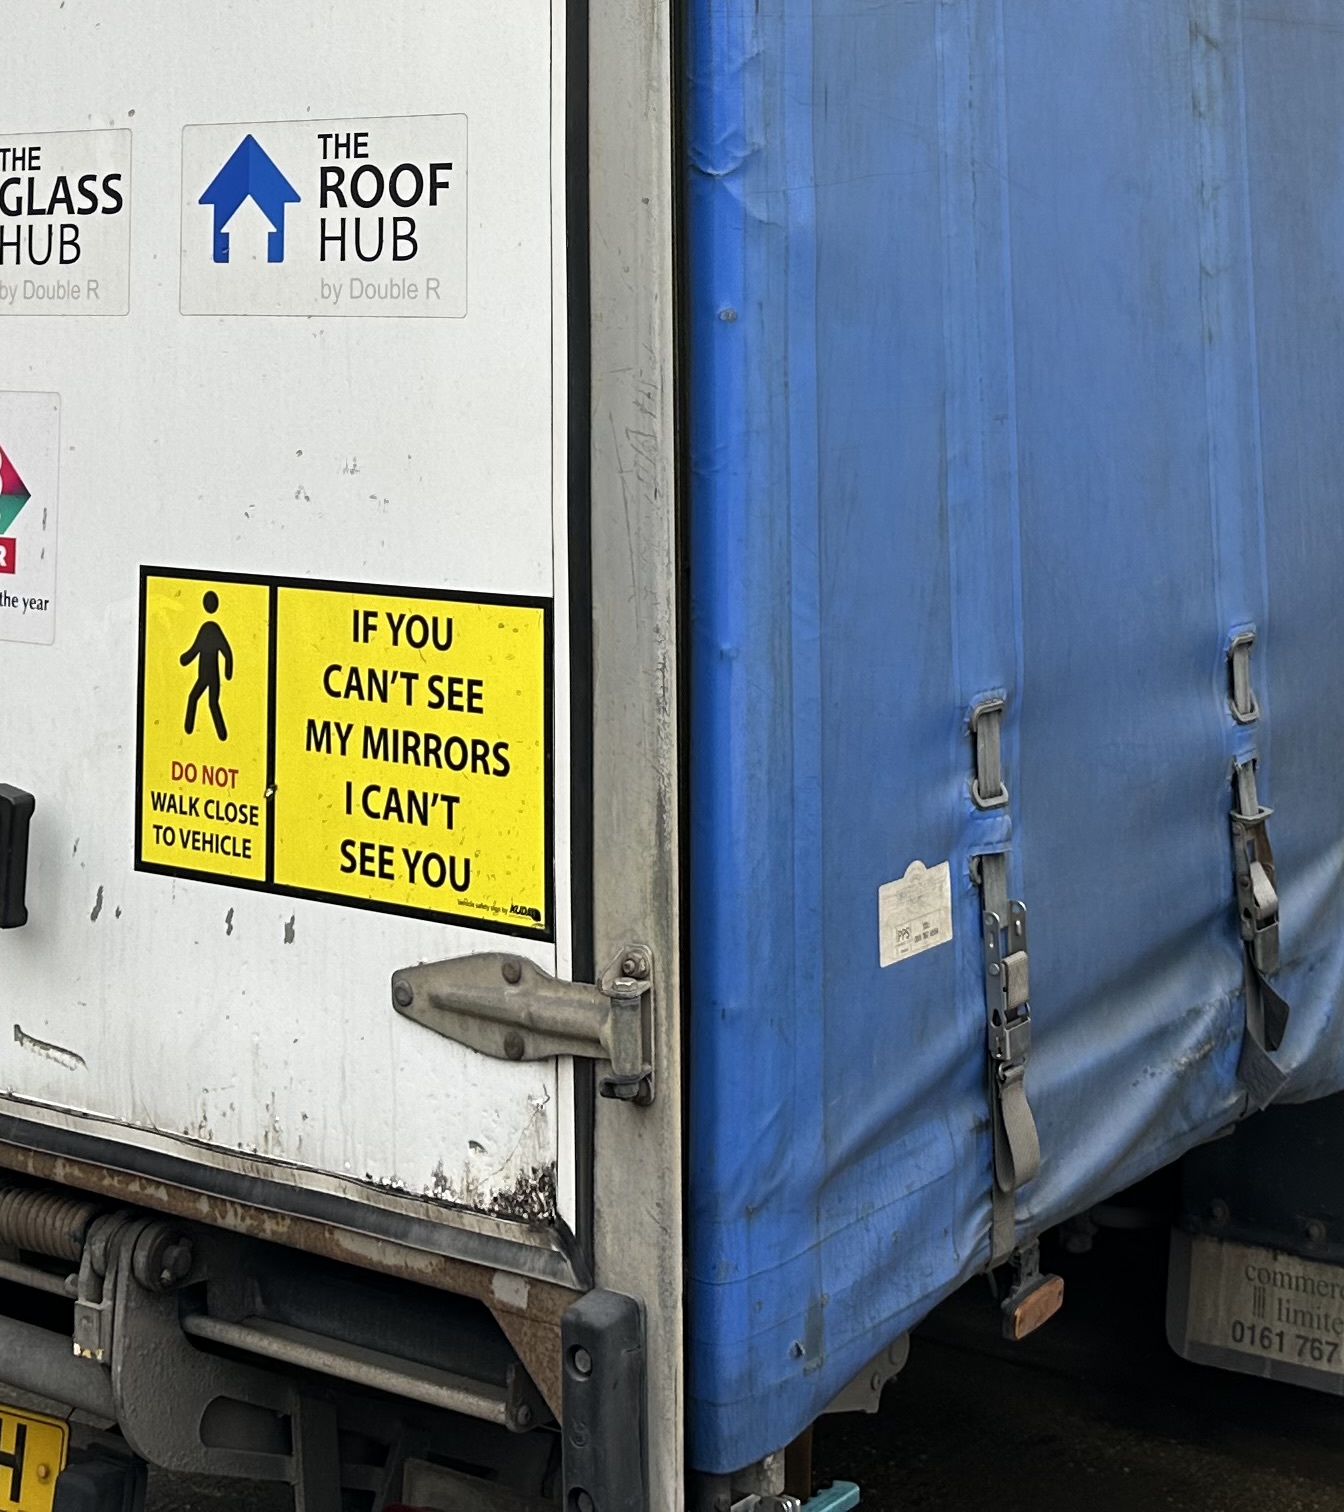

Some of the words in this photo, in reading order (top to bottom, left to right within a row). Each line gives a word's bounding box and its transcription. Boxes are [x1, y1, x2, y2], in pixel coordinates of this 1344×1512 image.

[317, 132, 369, 160] THE
[319, 162, 453, 208] ROOF
[319, 216, 418, 262] HUB
[23, 279, 82, 301] Double
[86, 280, 99, 300] R
[320, 277, 344, 304] by
[349, 277, 421, 301] Double
[426, 278, 441, 300] R
[0, 590, 19, 608] the
[23, 596, 49, 614] year
[352, 609, 378, 644] IF
[386, 612, 454, 652] YOU
[323, 663, 419, 707] CAN'T
[427, 675, 484, 714] SEE
[305, 718, 354, 757] MY
[362, 725, 511, 777] MIRRORS
[171, 760, 198, 783] DO
[202, 765, 239, 789] NOT
[151, 791, 200, 817] WALK
[204, 799, 259, 827] CLOSE
[345, 781, 352, 815] I
[362, 784, 460, 830] CAN'T
[153, 824, 176, 847] TO
[179, 828, 252, 859] VEHICLE
[340, 838, 395, 880] SEE
[402, 848, 471, 892] YOU
[1232, 1320, 1285, 1353] 0161
[1295, 1340, 1339, 1364] 767
